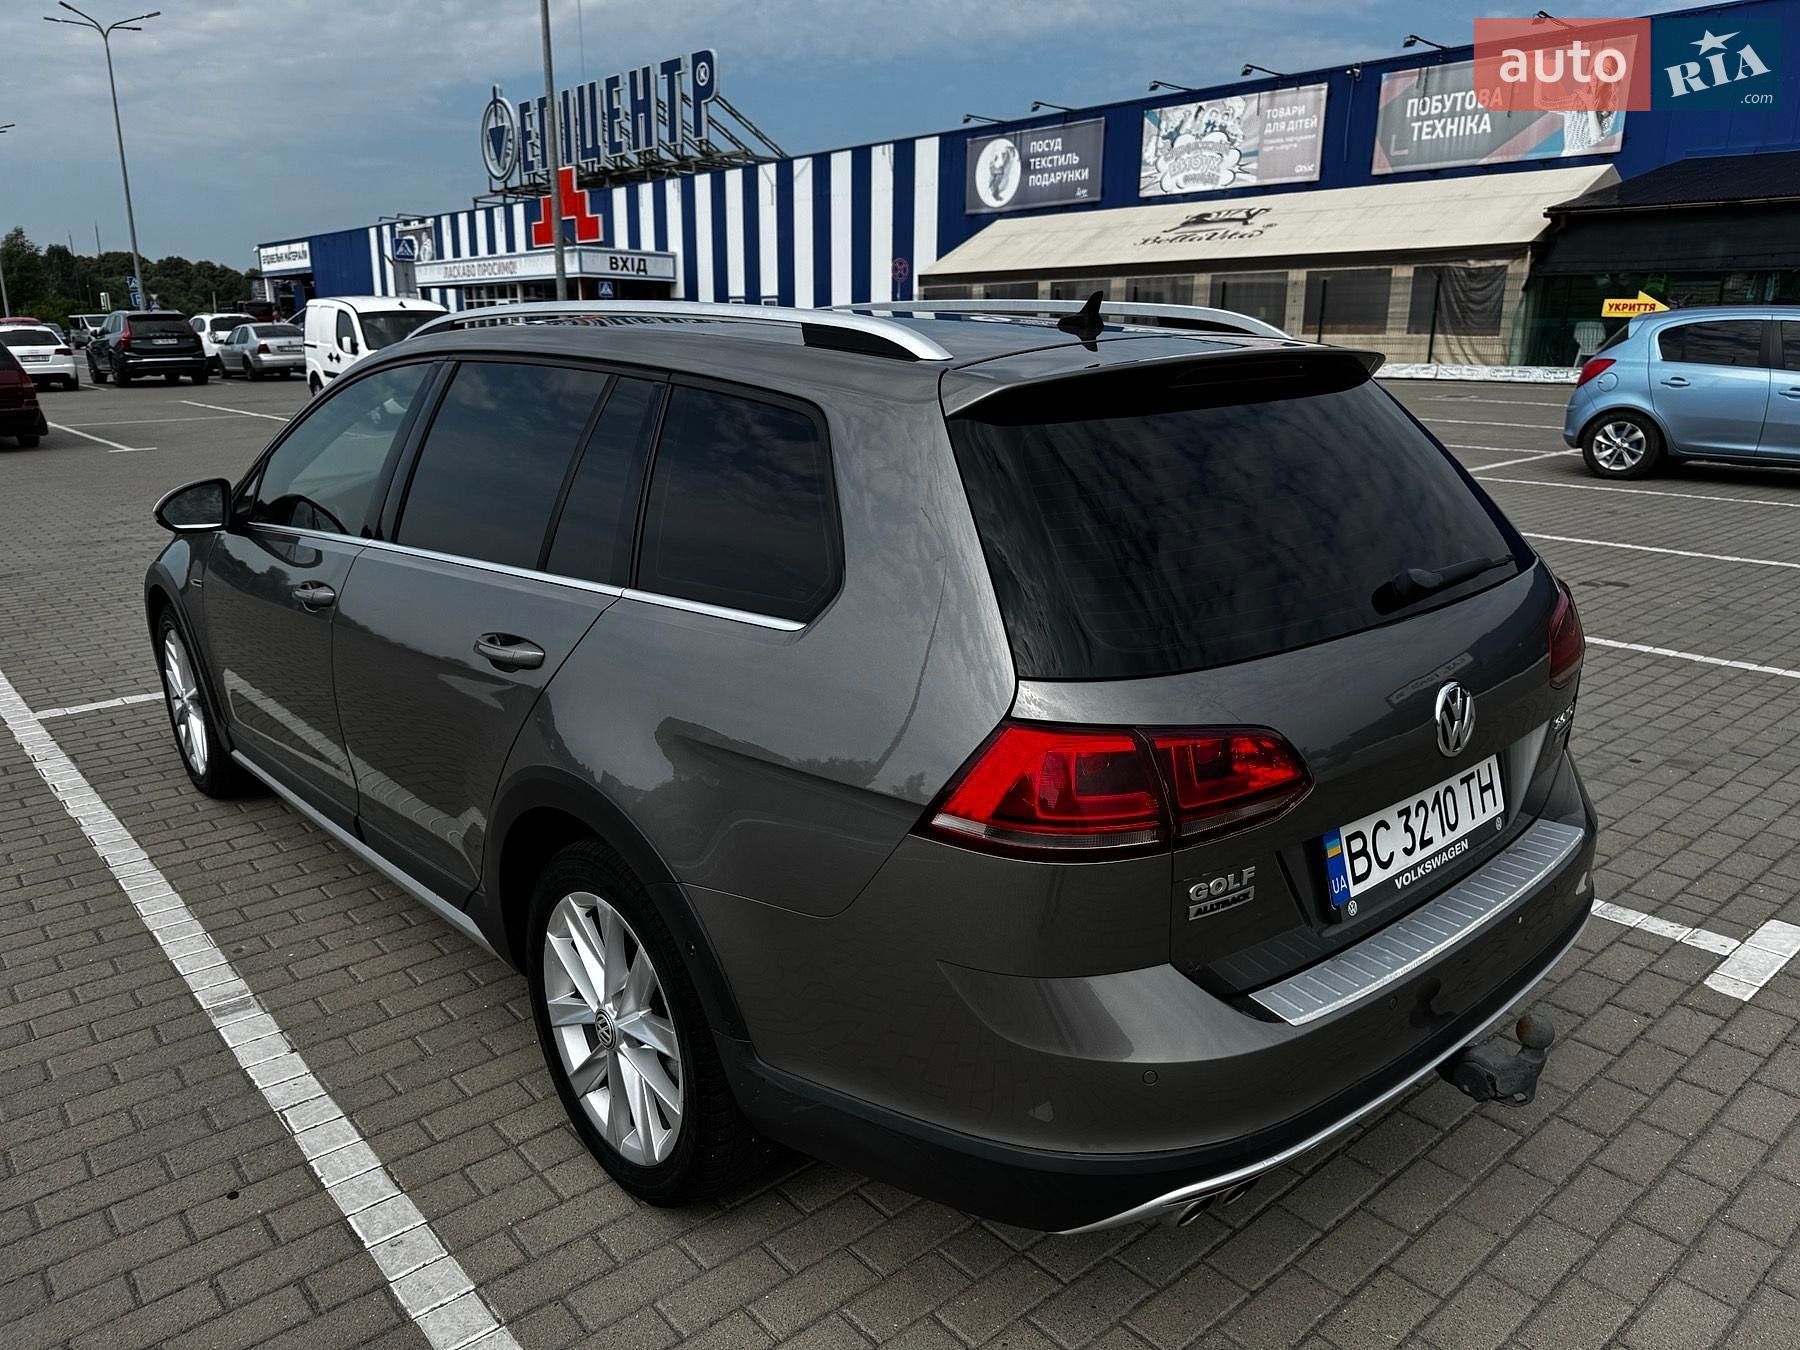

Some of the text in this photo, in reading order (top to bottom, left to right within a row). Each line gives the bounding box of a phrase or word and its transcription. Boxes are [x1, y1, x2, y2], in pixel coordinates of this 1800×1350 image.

[1266, 105, 1305, 119] ТОВАРИ
[1406, 86, 1503, 118] ПОБУТОВА
[1264, 114, 1317, 135] ДЛЯ ДІТЕЙ
[1411, 113, 1492, 141] ТЕХНІКА
[1029, 138, 1062, 153] ПОСУД
[1029, 152, 1079, 170] ТЕКСТИЛЬ
[1028, 167, 1089, 187] ПОДАРУНКИ
[609, 256, 648, 275] ВХІД
[1608, 302, 1656, 312] УКРИТТЯ
[1345, 763, 1497, 886] BC 3210 TH
[1395, 839, 1469, 890] VOLKSWAGEN
[1189, 866, 1255, 901] GOLF
[1332, 874, 1348, 894] UA
